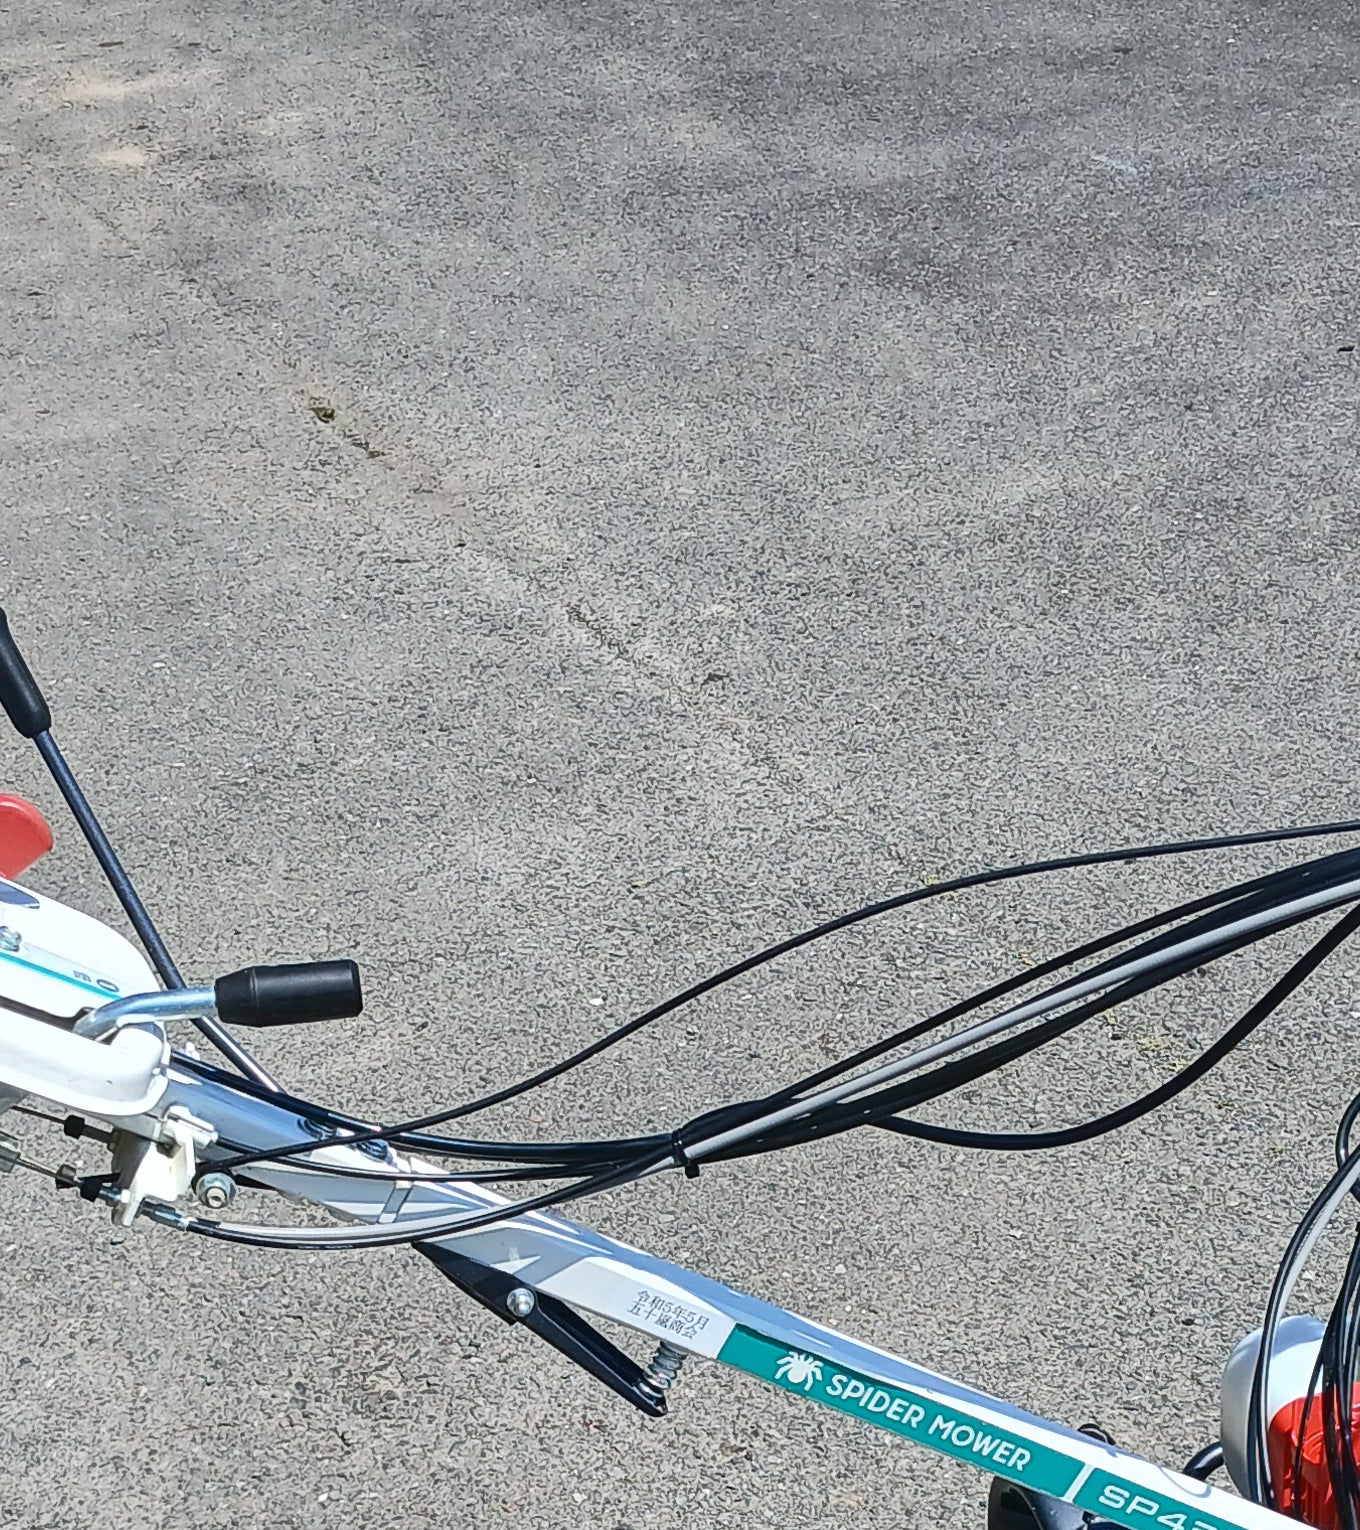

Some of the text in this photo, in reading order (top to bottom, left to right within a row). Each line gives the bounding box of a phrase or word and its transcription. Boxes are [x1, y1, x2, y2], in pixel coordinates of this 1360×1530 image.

[637, 1290, 710, 1330] 令和5年5月
[825, 1374, 1032, 1471] SPIDER MOWER
